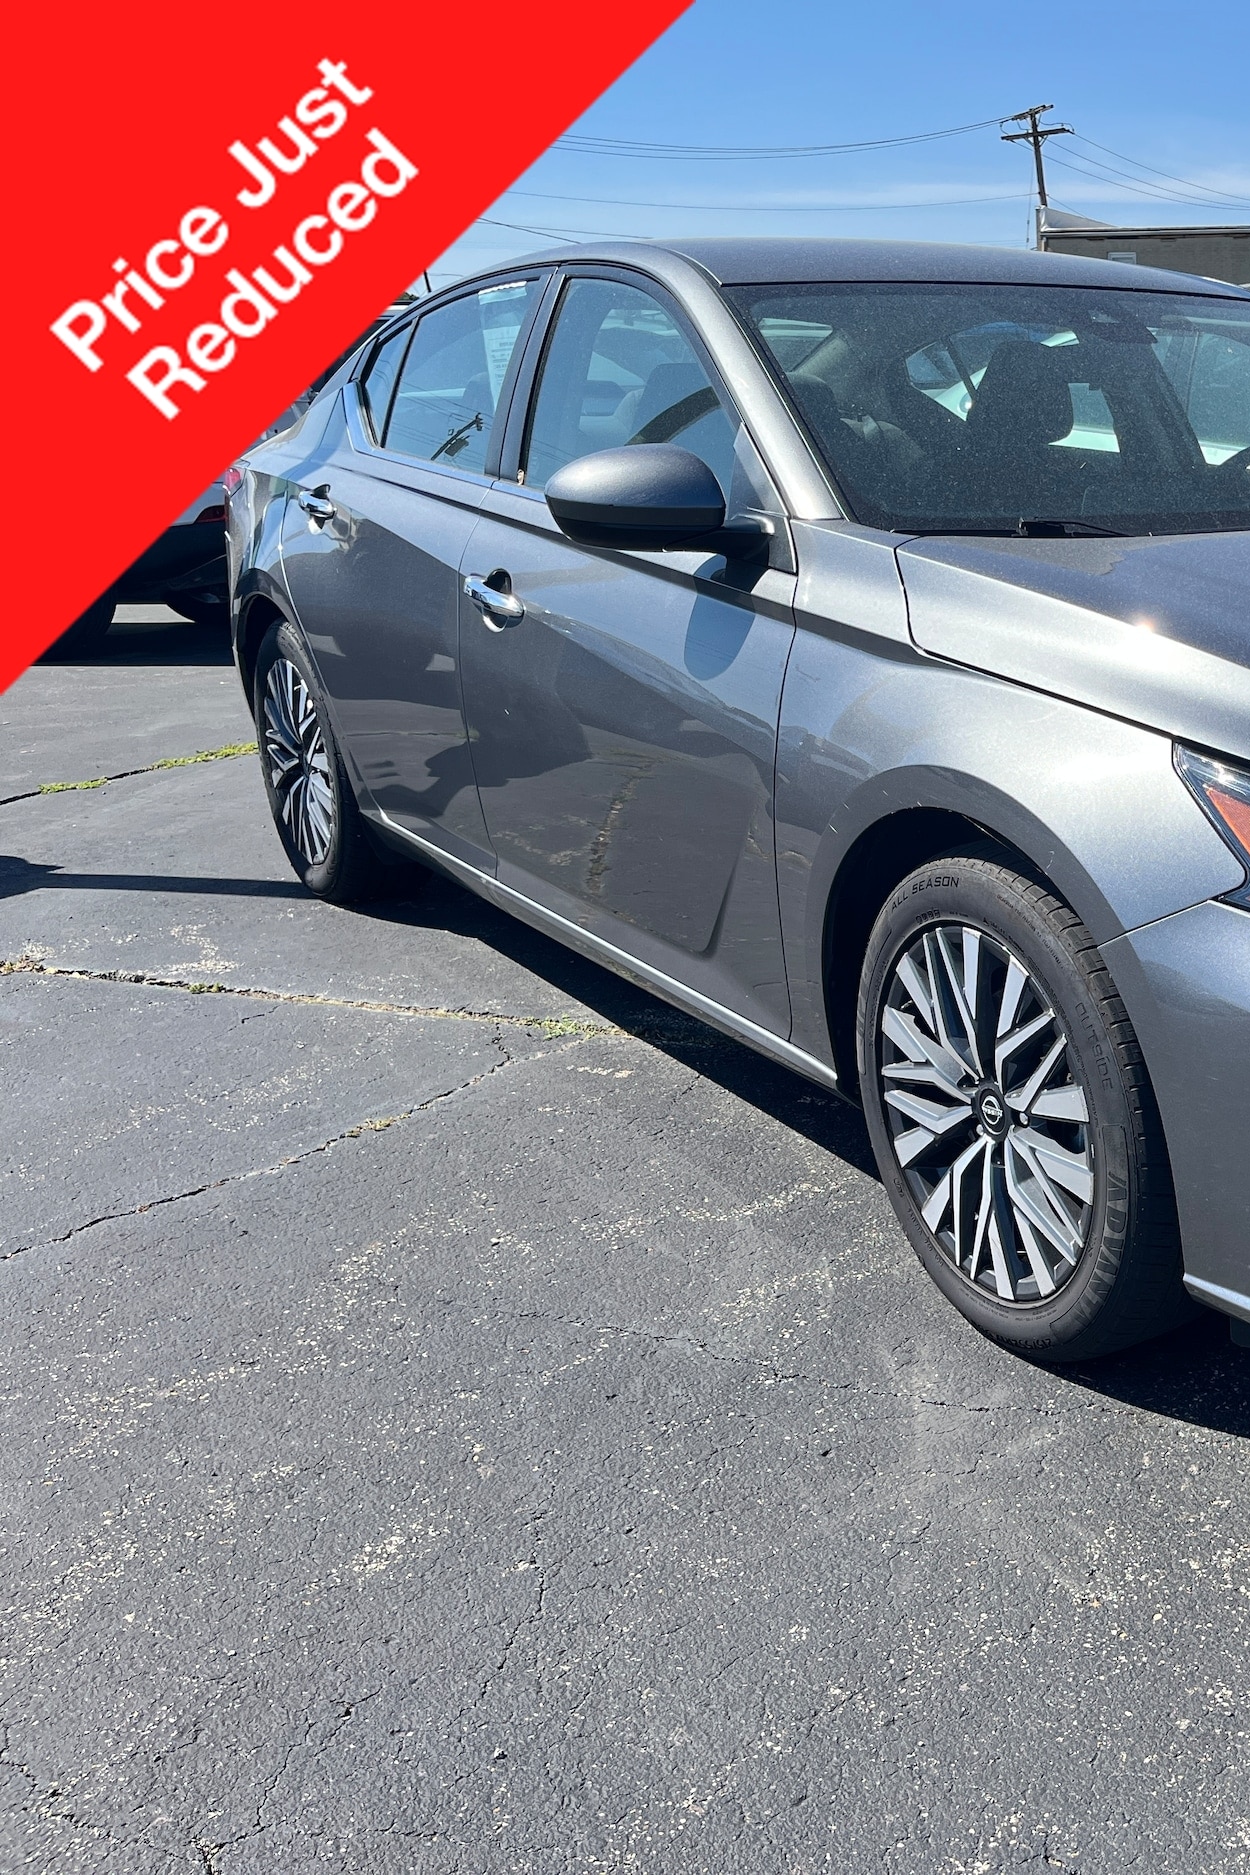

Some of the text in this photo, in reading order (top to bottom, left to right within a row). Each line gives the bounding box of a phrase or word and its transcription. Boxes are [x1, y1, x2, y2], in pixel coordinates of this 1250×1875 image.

[891, 876, 960, 913] ALL SEASON
[1075, 1002, 1114, 1091] OUTSIDE
